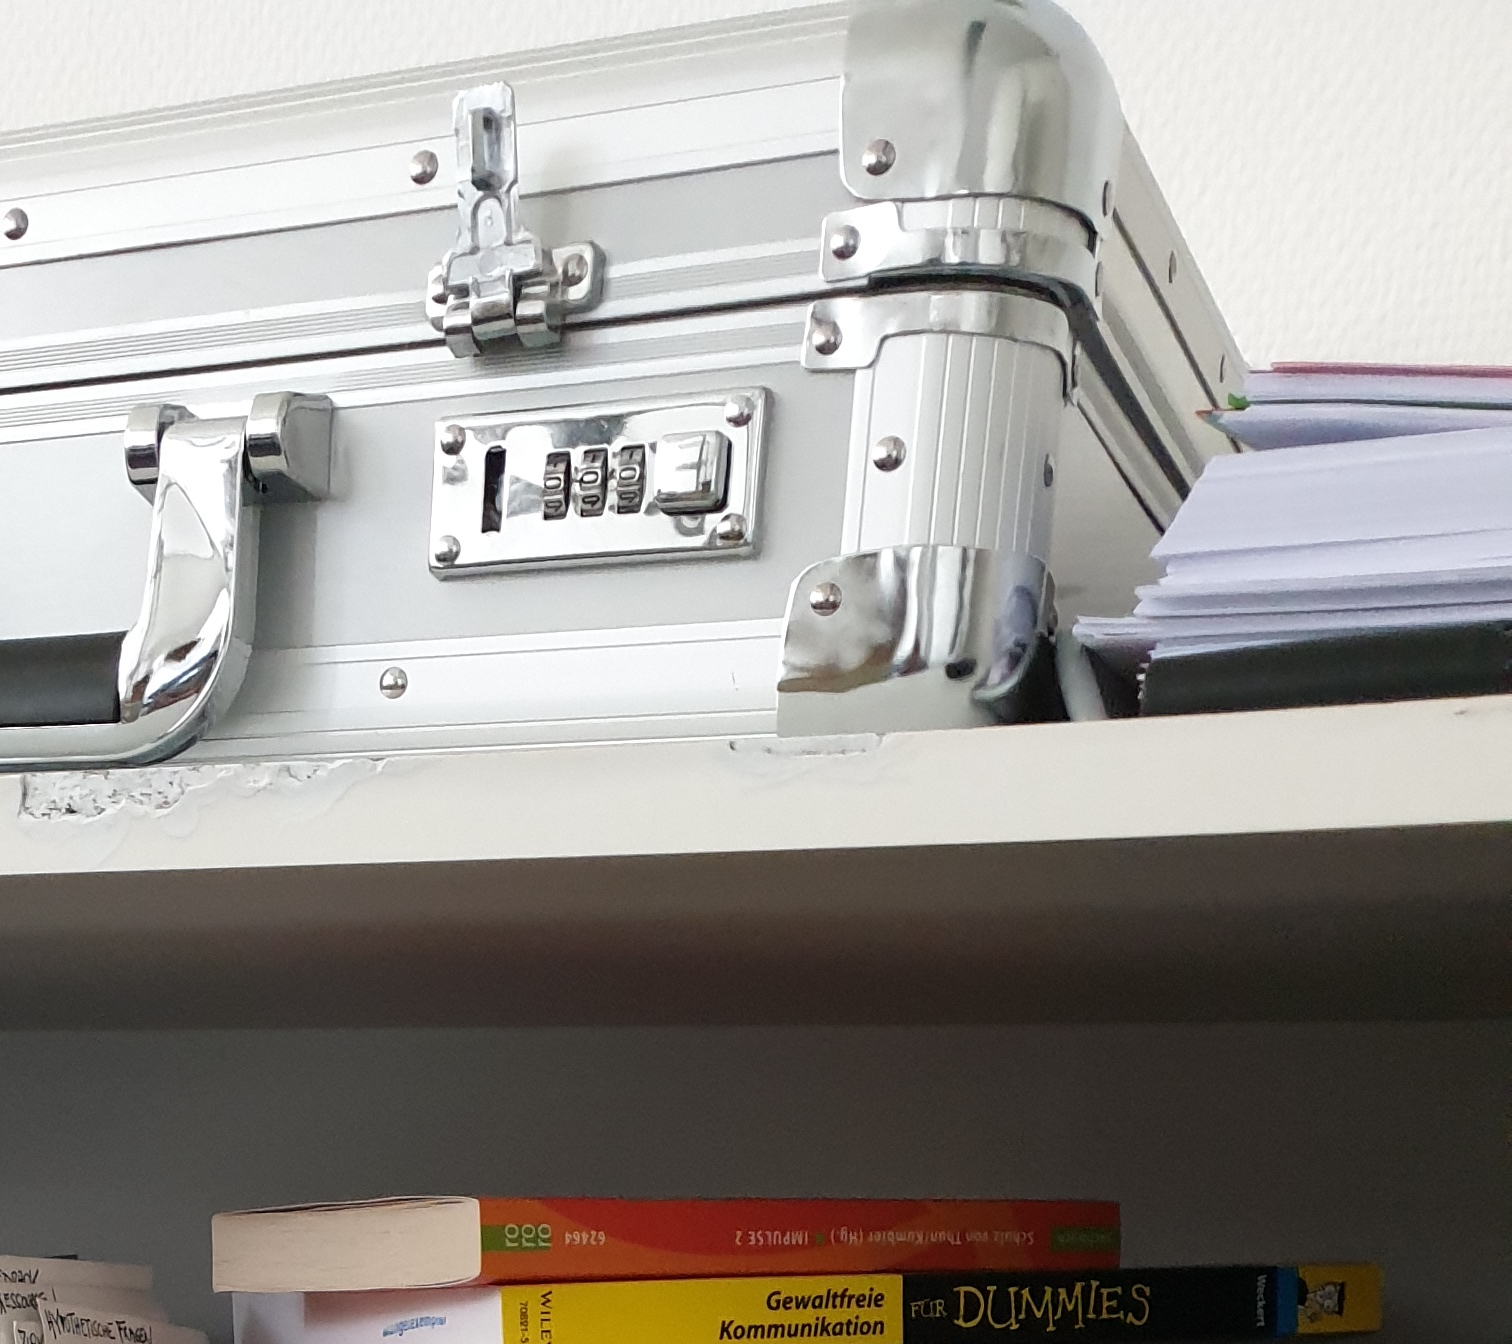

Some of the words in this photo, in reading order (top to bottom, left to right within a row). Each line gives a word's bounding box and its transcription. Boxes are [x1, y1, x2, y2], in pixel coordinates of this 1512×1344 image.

[765, 1286, 885, 1314] Gewaltfreie
[953, 1282, 1151, 1331] DUMMIES
[718, 1313, 885, 1343] Kommunikation
